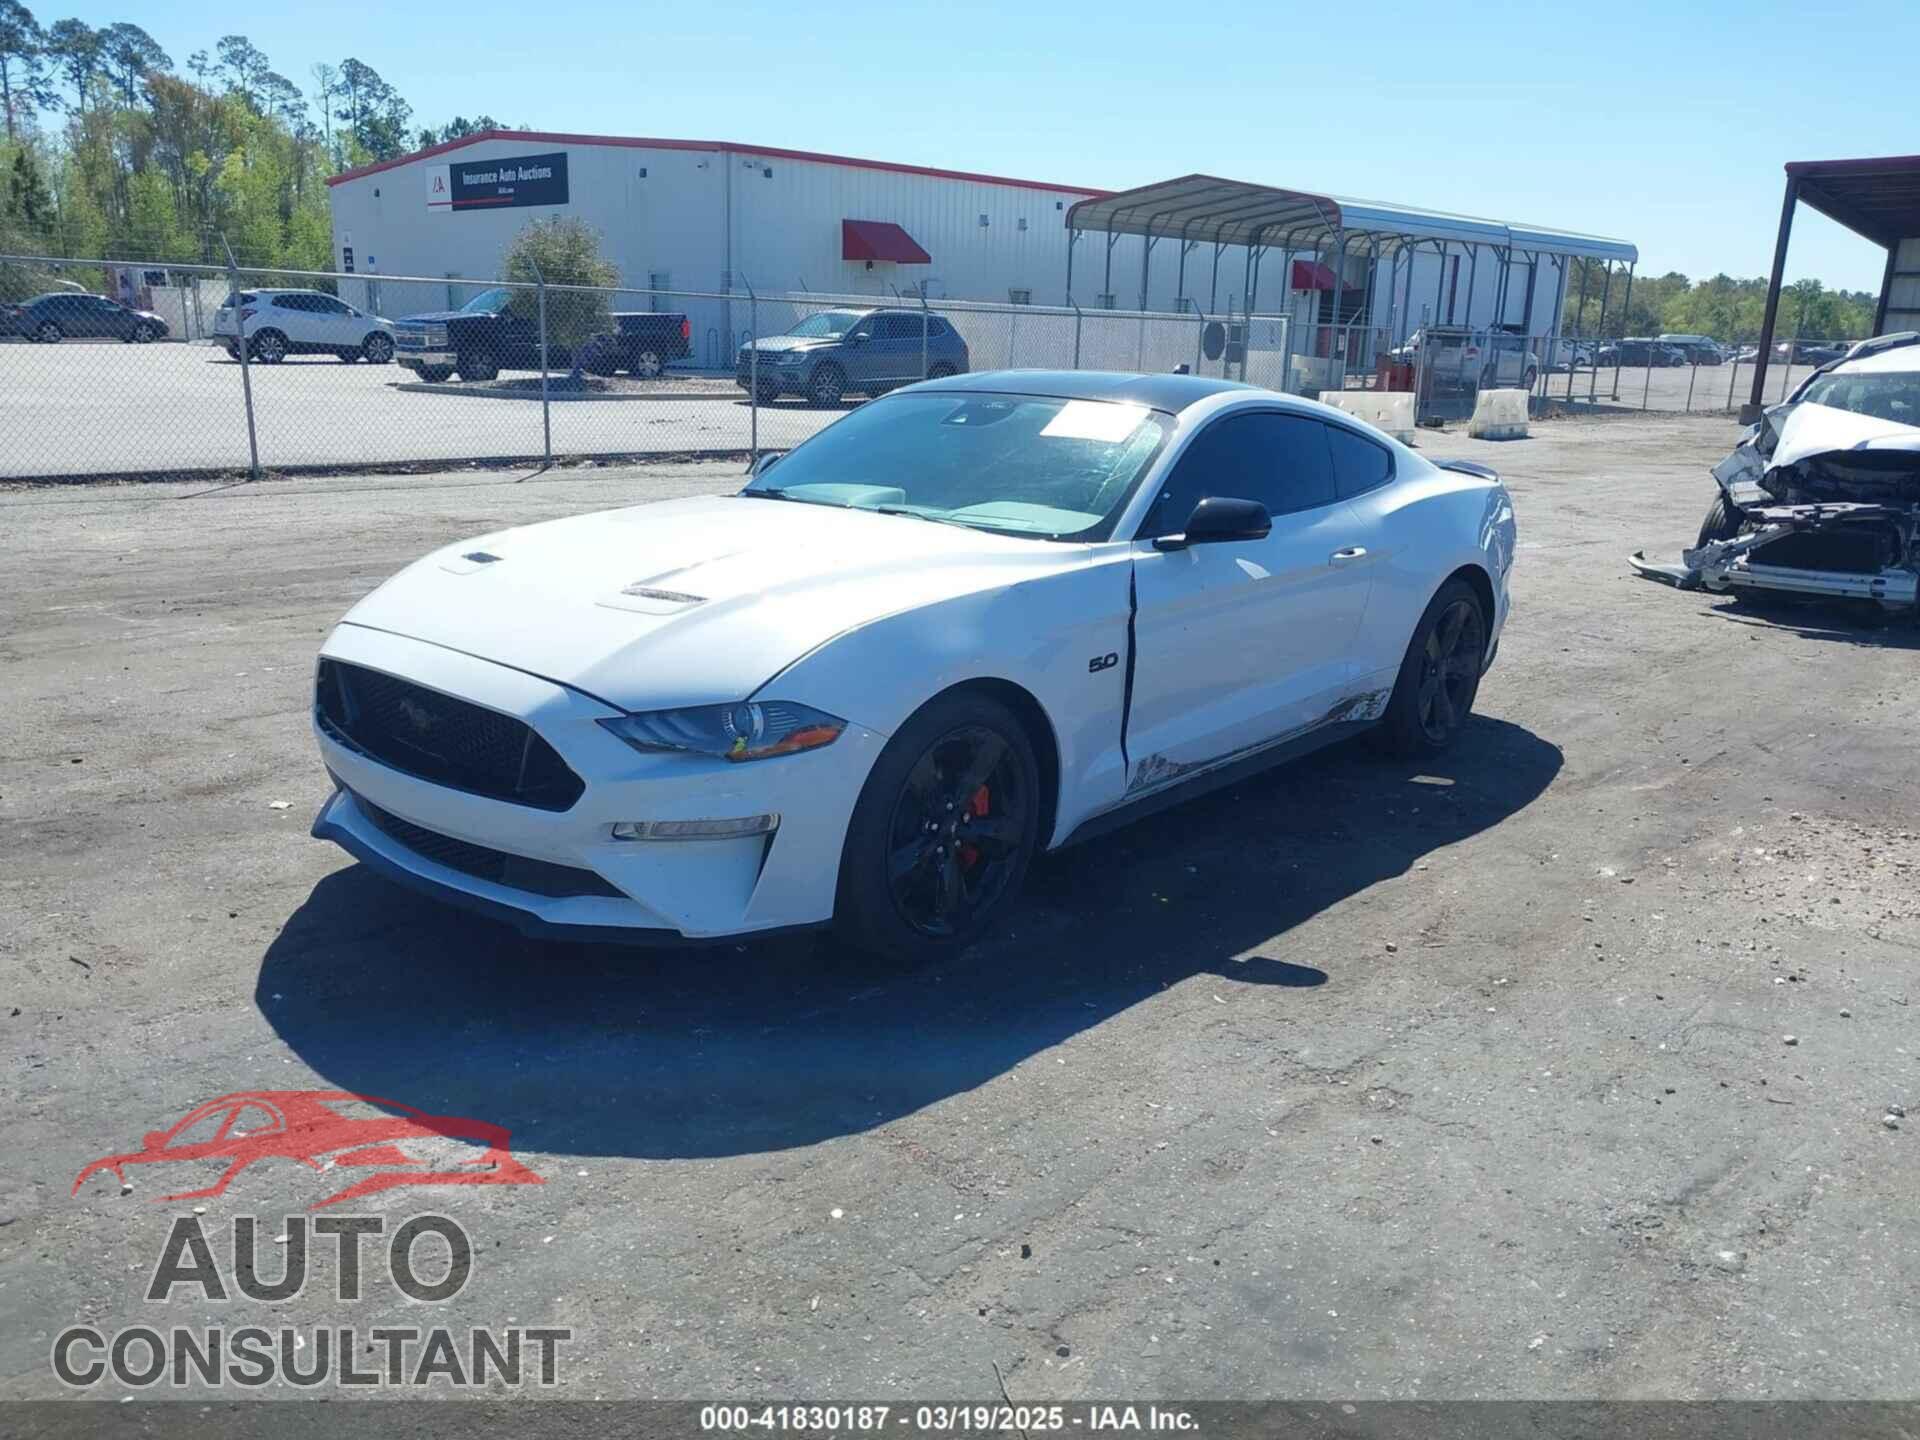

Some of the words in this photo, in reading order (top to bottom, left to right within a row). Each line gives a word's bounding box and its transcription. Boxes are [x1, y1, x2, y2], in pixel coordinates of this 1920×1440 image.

[463, 172, 497, 185] Insurance
[499, 167, 516, 182] Auto
[517, 165, 552, 181] Auctions
